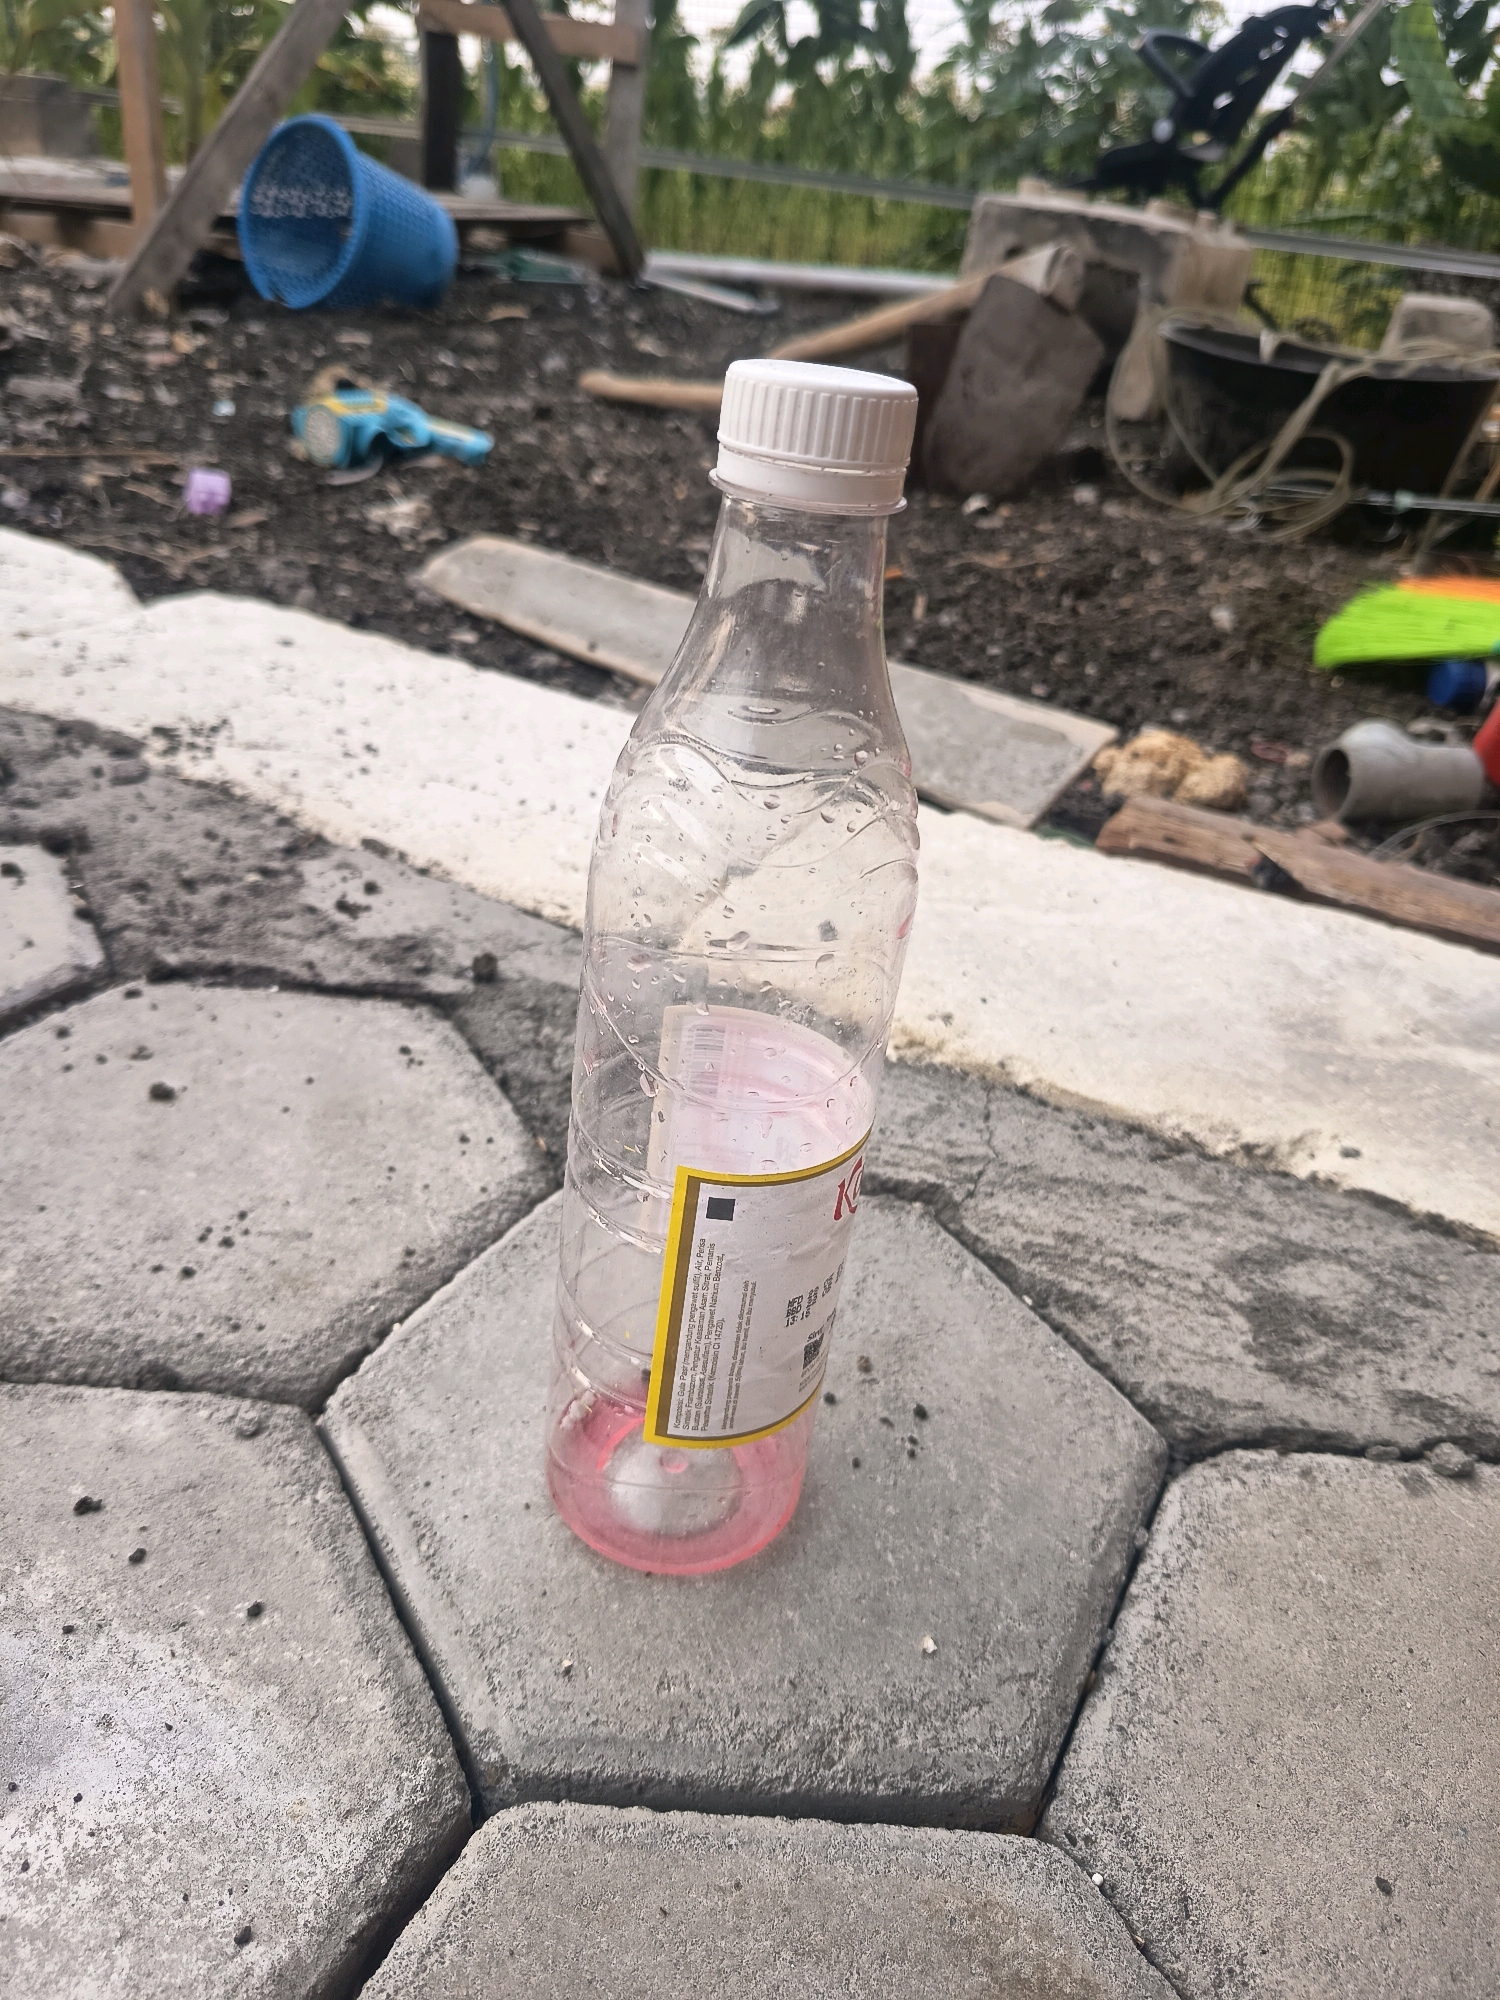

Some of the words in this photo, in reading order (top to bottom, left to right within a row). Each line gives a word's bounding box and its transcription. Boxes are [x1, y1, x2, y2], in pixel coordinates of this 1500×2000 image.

[696, 1239, 705, 1258] Perisa
[699, 1293, 708, 1310] Asam
[704, 1243, 715, 1271] Pemanis
[689, 1292, 698, 1323] pengawet
[705, 1309, 715, 1339] Pengawet
[713, 1254, 725, 1281] Benzoat,
[682, 1324, 695, 1365] (mengandung
[680, 1365, 688, 1380] Pasir
[677, 1382, 686, 1396] Gula
